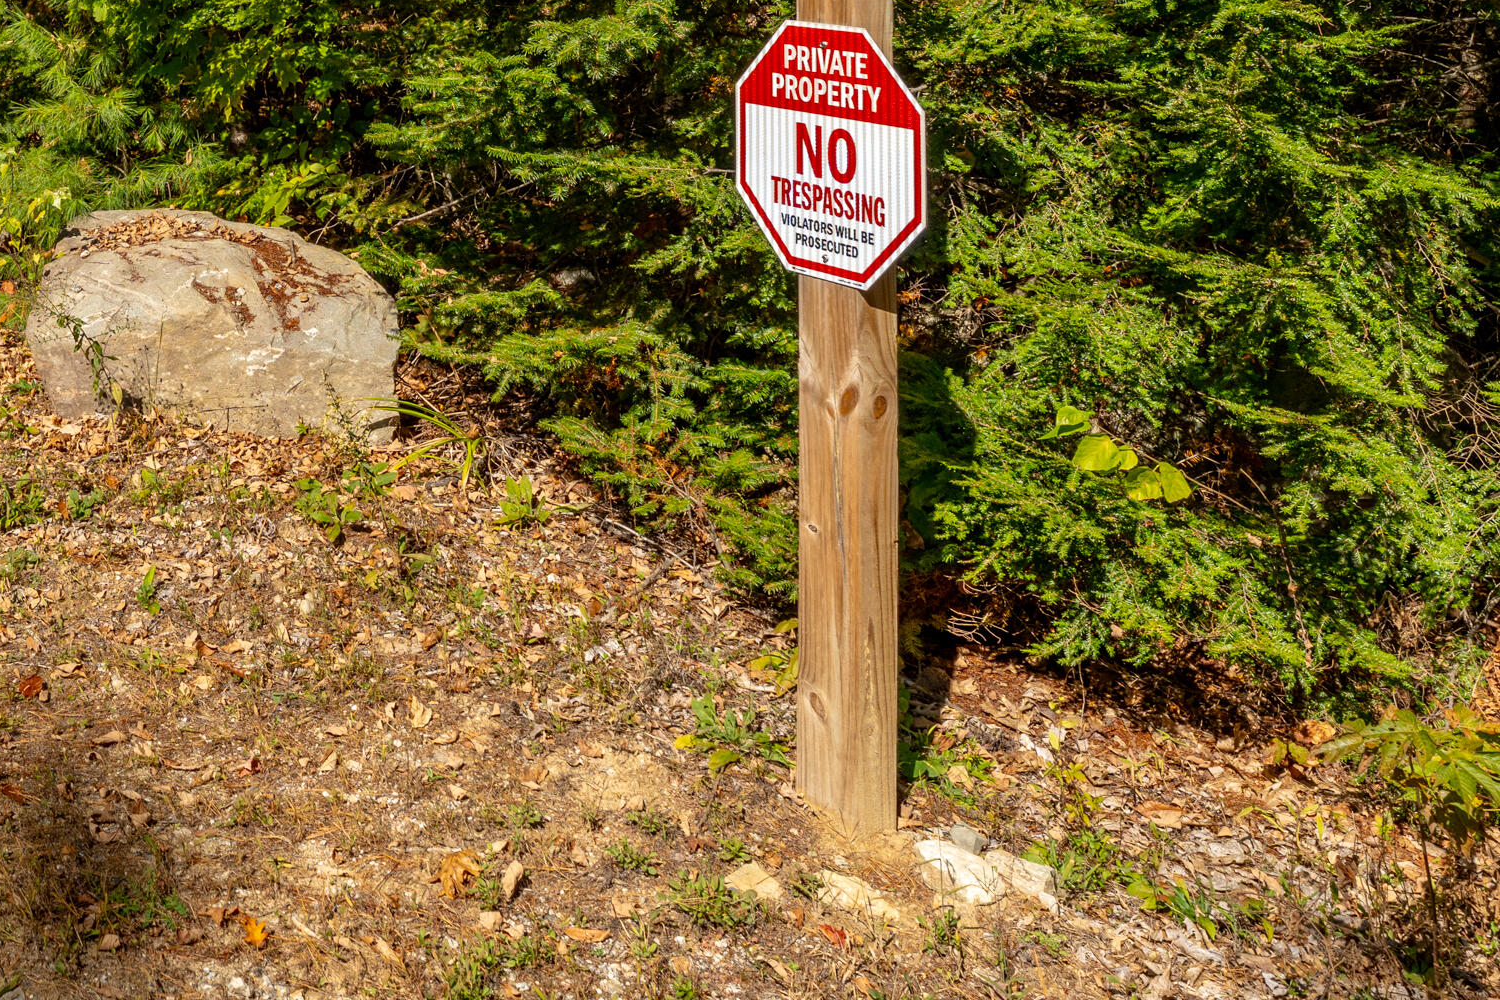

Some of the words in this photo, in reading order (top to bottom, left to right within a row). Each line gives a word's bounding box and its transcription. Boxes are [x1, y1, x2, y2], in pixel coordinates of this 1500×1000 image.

[783, 44, 869, 80] PRIVATE
[771, 72, 881, 113] PROPERTY
[796, 121, 857, 184] NO
[771, 175, 886, 228] TRESPASSING
[781, 212, 833, 236] VIOLATORS
[835, 223, 859, 242] WILL
[861, 230, 875, 246] BE
[795, 232, 859, 259] PROSECUTED
